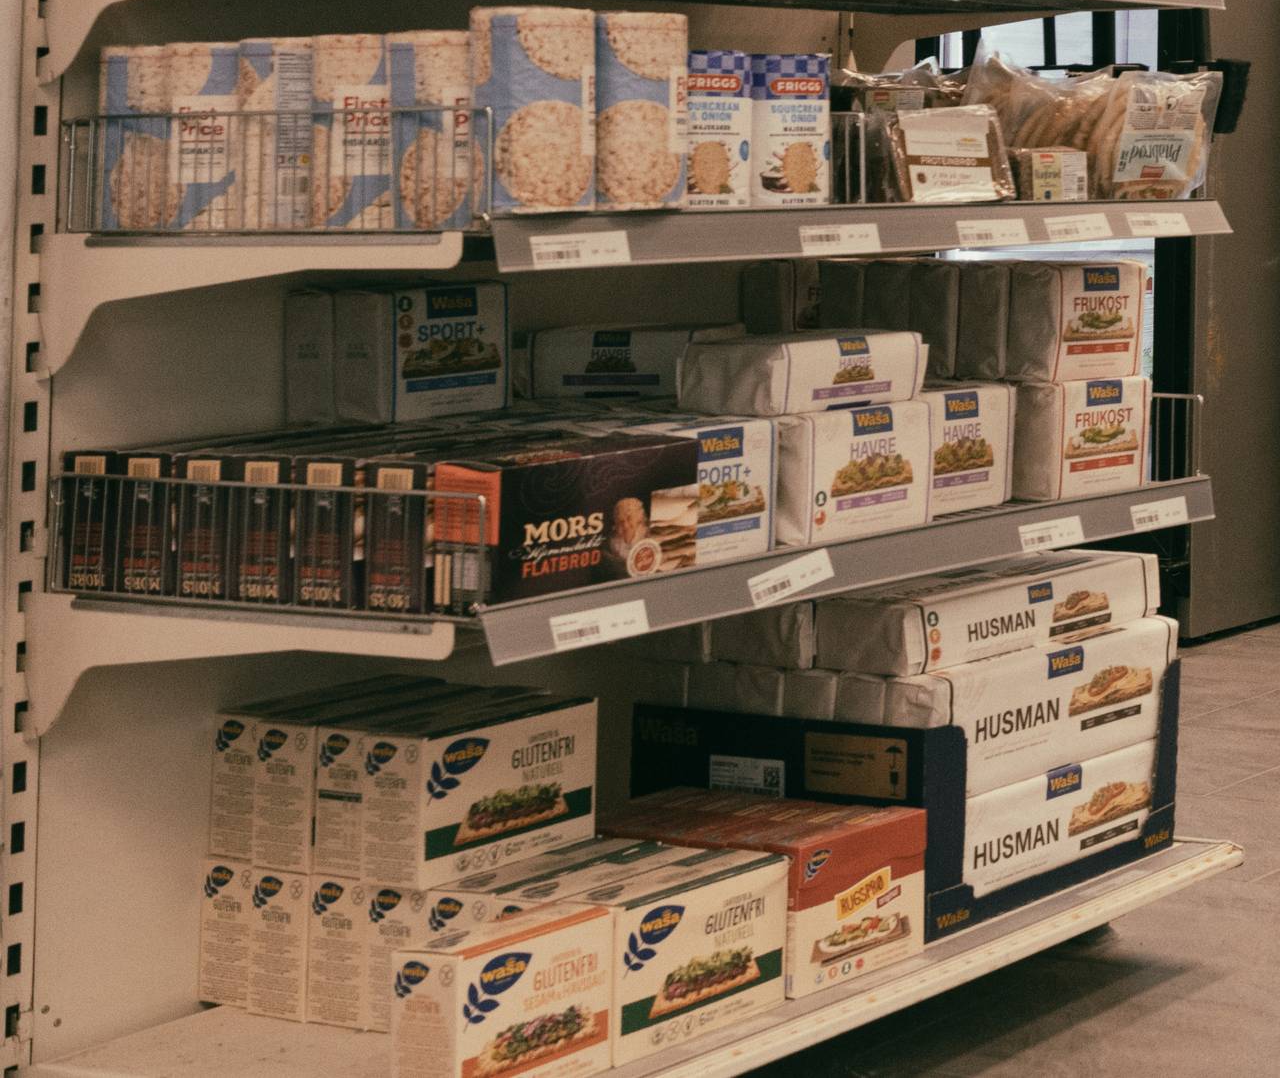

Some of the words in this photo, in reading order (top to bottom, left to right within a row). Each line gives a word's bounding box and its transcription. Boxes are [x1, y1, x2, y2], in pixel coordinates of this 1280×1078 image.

[688, 76, 737, 89] FRIGGS
[776, 80, 823, 91] FRIGGS
[688, 101, 740, 111] OURCREAM
[1073, 296, 1130, 313] FRUKOST
[1074, 408, 1134, 428] FRUKOST
[942, 423, 983, 443] HAVRE
[849, 437, 897, 460] HAVRE
[698, 466, 752, 485] PORT+
[523, 511, 604, 546] MORS
[521, 549, 602, 580] FLATBRØD
[966, 608, 1037, 644] HUSMAN
[974, 697, 1061, 744] HUSMAN
[511, 735, 575, 770] GLUTENFRI
[972, 817, 1060, 870] HUSMAN
[704, 895, 766, 935] GLUTENFRI
[533, 952, 599, 992] GLUTENFRI
